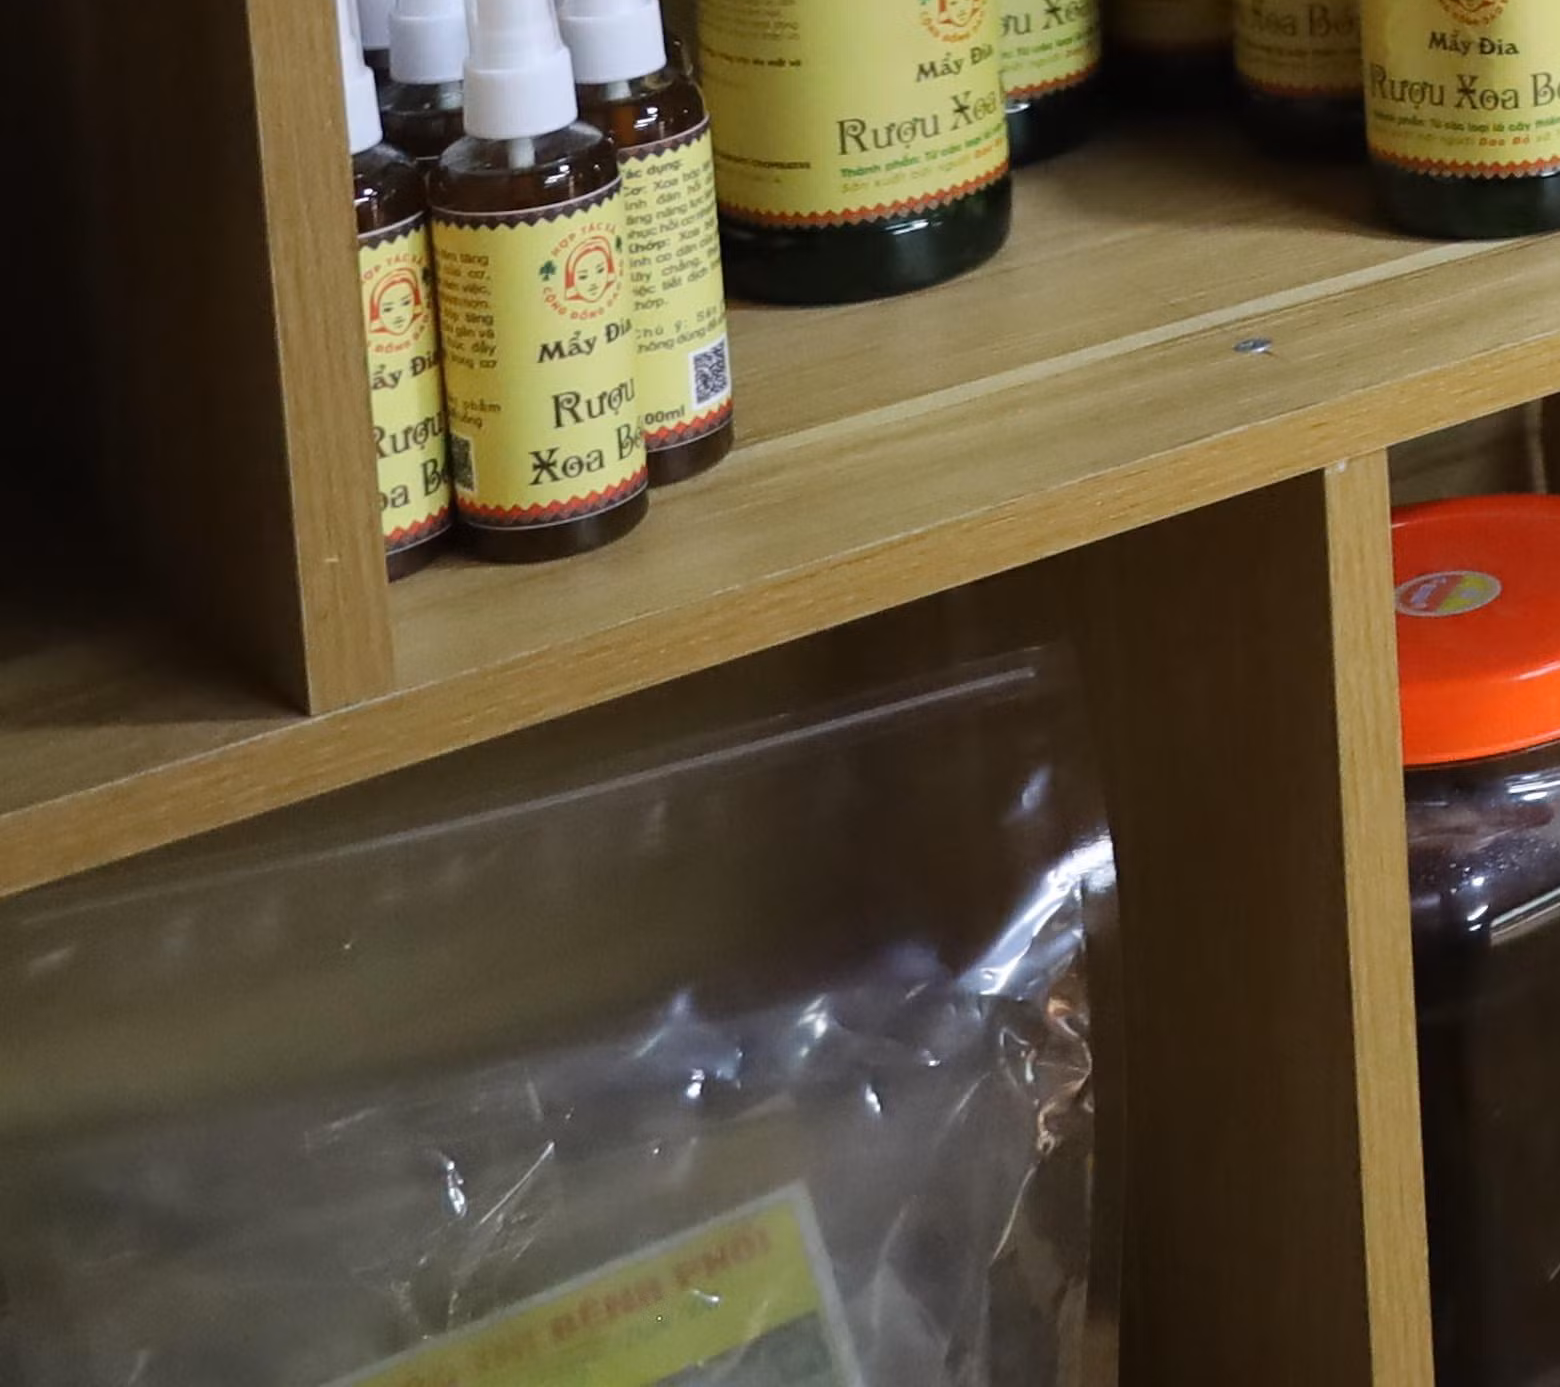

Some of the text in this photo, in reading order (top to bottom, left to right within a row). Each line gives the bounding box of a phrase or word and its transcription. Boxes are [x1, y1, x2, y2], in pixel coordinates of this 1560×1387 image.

[1426, 27, 1475, 57] Mẩy
[914, 50, 964, 83] Mẩy
[1369, 63, 1446, 111] Rượu
[1452, 73, 1521, 112] Xoa
[836, 112, 941, 156] Rượu
[536, 330, 599, 365] Mẩy
[371, 363, 403, 392] ẩy
[551, 377, 636, 430] Rượu
[643, 404, 686, 426] 00ml
[527, 444, 606, 487] Xoa
